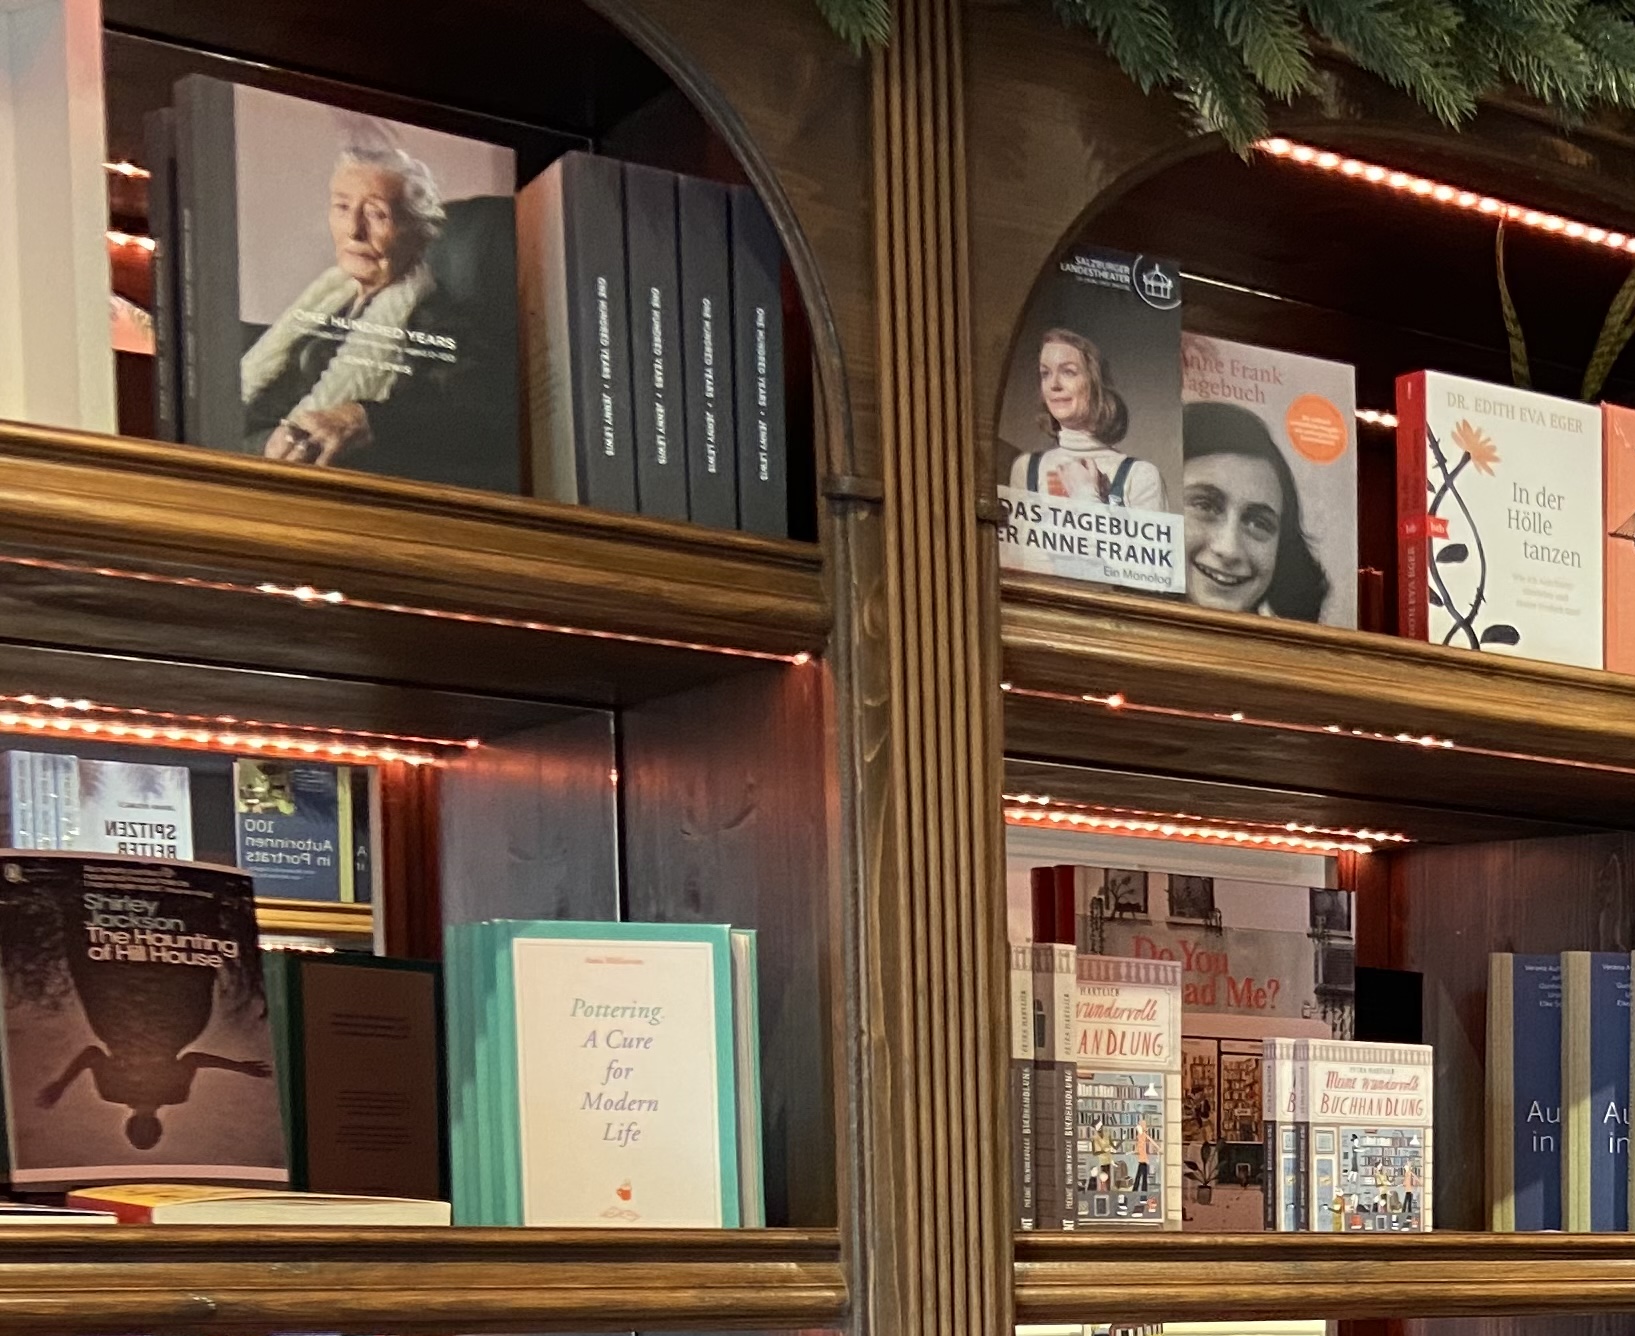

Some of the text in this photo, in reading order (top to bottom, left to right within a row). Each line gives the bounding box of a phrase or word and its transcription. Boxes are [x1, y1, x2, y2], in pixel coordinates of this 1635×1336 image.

[405, 329, 457, 351] YEARS
[1230, 355, 1285, 386] Frank
[1446, 391, 1583, 434] DR. EDITH EVA EGER
[1512, 482, 1565, 512] In der
[1048, 507, 1173, 543] TAGEBUCH
[1507, 507, 1553, 537] Hölle
[1026, 530, 1089, 556] ANNE
[1096, 540, 1174, 569] FRANK
[1522, 540, 1582, 569] tanzen
[1103, 565, 1173, 588] Ein Monolog
[85, 925, 240, 959] The Haunting
[149, 946, 224, 968] House
[1178, 939, 1230, 977] You
[1226, 976, 1280, 1010] Me?
[580, 1029, 654, 1050] A Cure
[601, 1059, 634, 1086] for
[579, 1091, 659, 1113] Modern
[1320, 1092, 1424, 1117] BUCHHANDLUNG
[602, 1121, 641, 1148] Life
